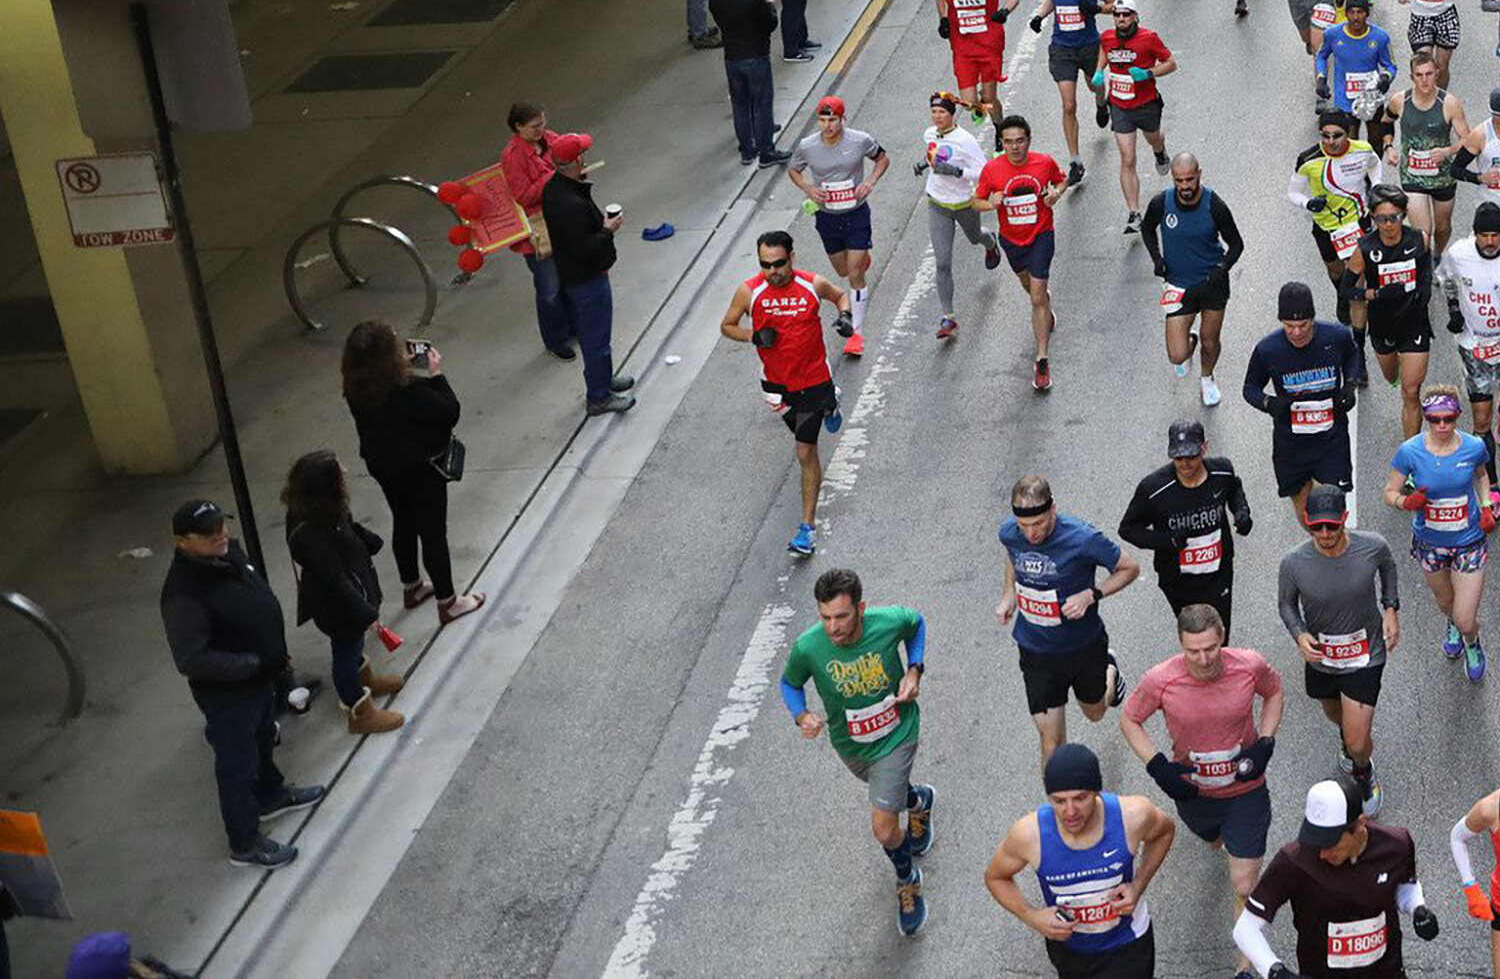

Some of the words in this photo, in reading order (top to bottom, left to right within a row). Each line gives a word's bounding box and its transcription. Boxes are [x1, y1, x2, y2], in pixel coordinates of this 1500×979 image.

[82, 234, 112, 247] TOW
[123, 230, 164, 243] ZONE
[762, 297, 807, 308] GARZA
[1469, 292, 1491, 303] CHI
[1478, 306, 1496, 316] CA
[1430, 510, 1436, 519] B
[1439, 508, 1463, 519] 5274
[1185, 551, 1192, 562] B
[1196, 547, 1219, 562] 2261
[1025, 560, 1042, 568] NYC
[1326, 646, 1333, 656] B
[1336, 643, 1362, 656] 9239
[852, 723, 861, 734] B
[1077, 867, 1109, 877] AMERICA
[1080, 904, 1112, 921] 1287
[1332, 940, 1342, 952] D
[1348, 930, 1384, 952] 18096
